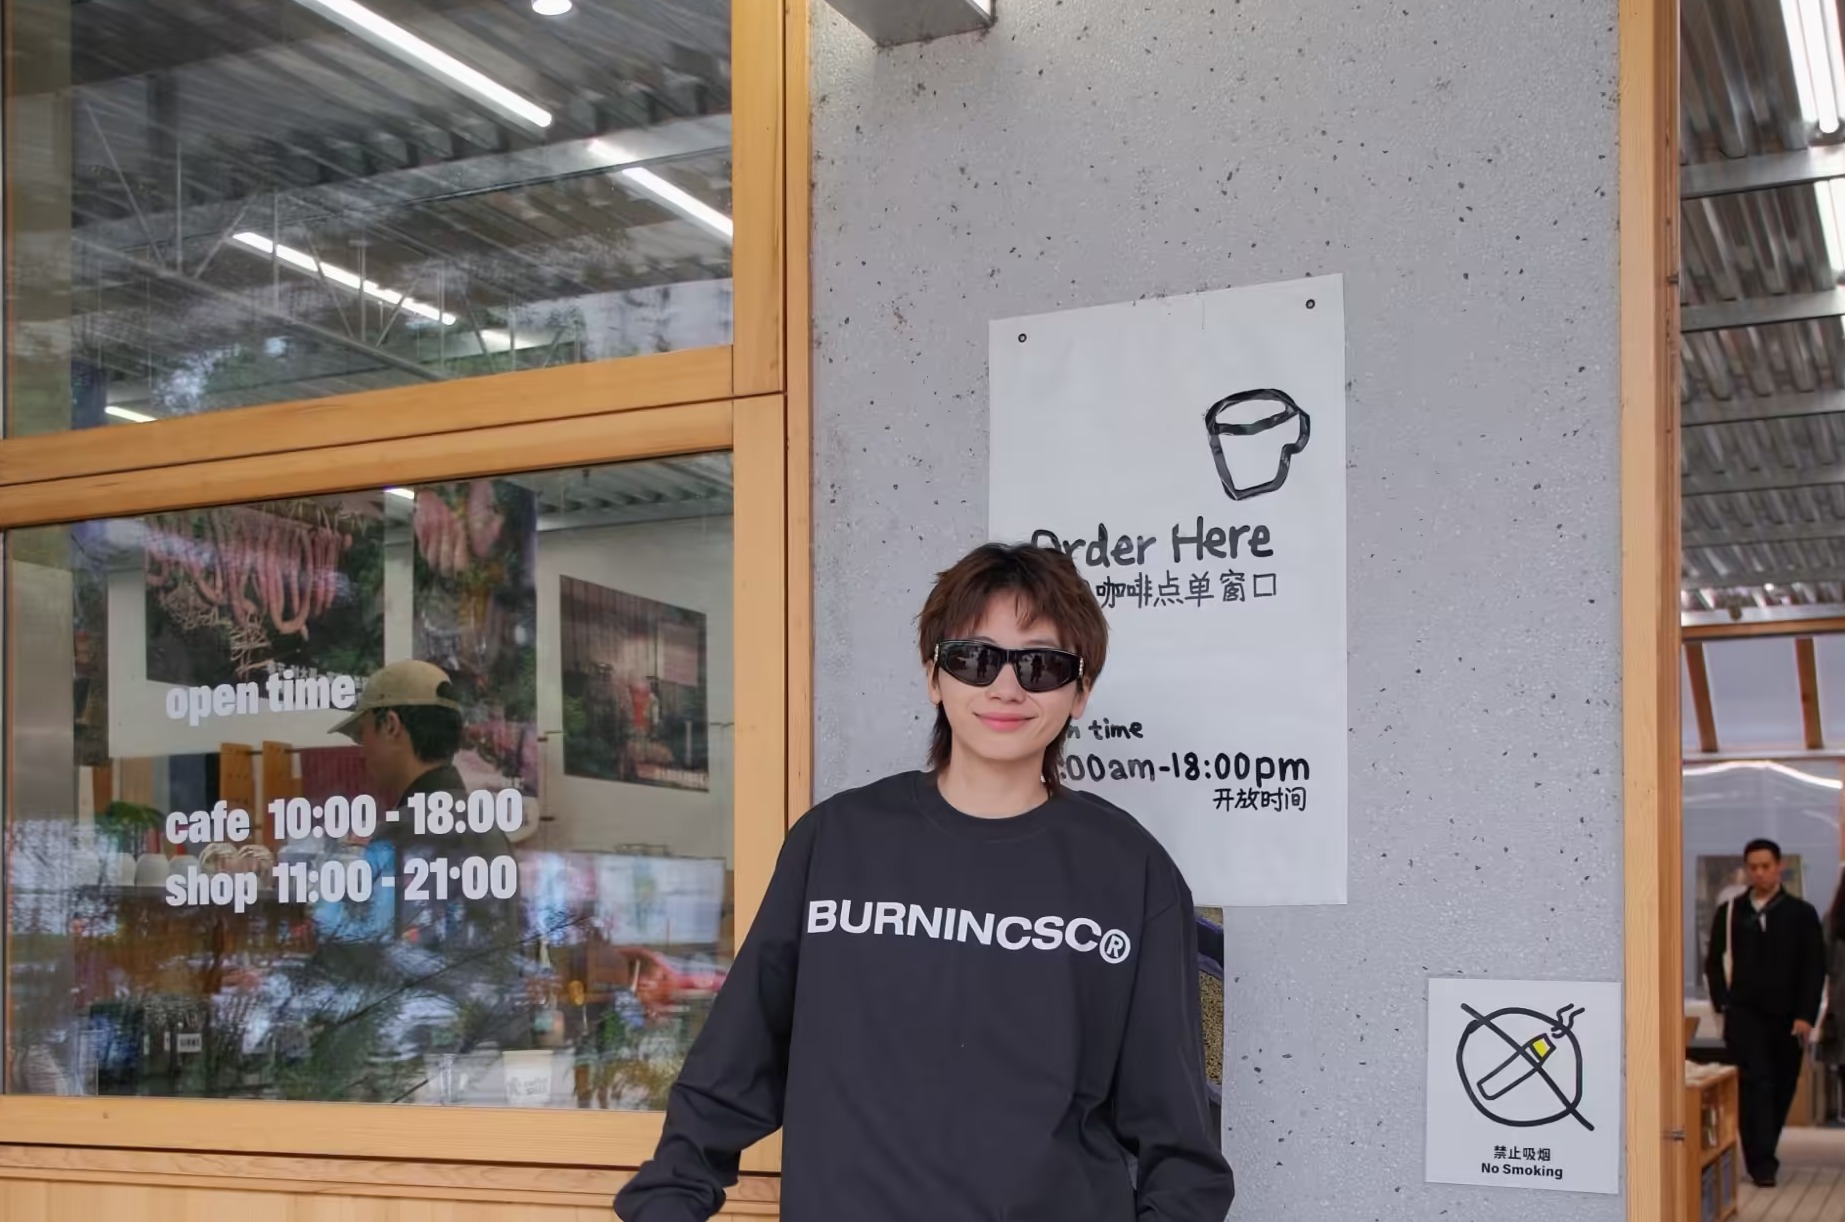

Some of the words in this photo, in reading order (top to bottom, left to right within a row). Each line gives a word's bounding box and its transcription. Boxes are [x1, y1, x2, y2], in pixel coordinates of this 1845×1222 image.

[1172, 516, 1274, 563] Here
[166, 682, 259, 726] open
[265, 669, 355, 712] time
[1088, 718, 1143, 740] time
[165, 800, 250, 844] cafe
[268, 794, 377, 840] 10:00
[408, 789, 523, 835] 18:00
[1213, 787, 1306, 811] 开放时间
[165, 866, 258, 913] shop
[273, 859, 372, 903] 11:00
[1493, 1145, 1551, 1161] 禁止吸烟
[1481, 1163, 1500, 1174] No
[1502, 1164, 1563, 1180] Smoking
